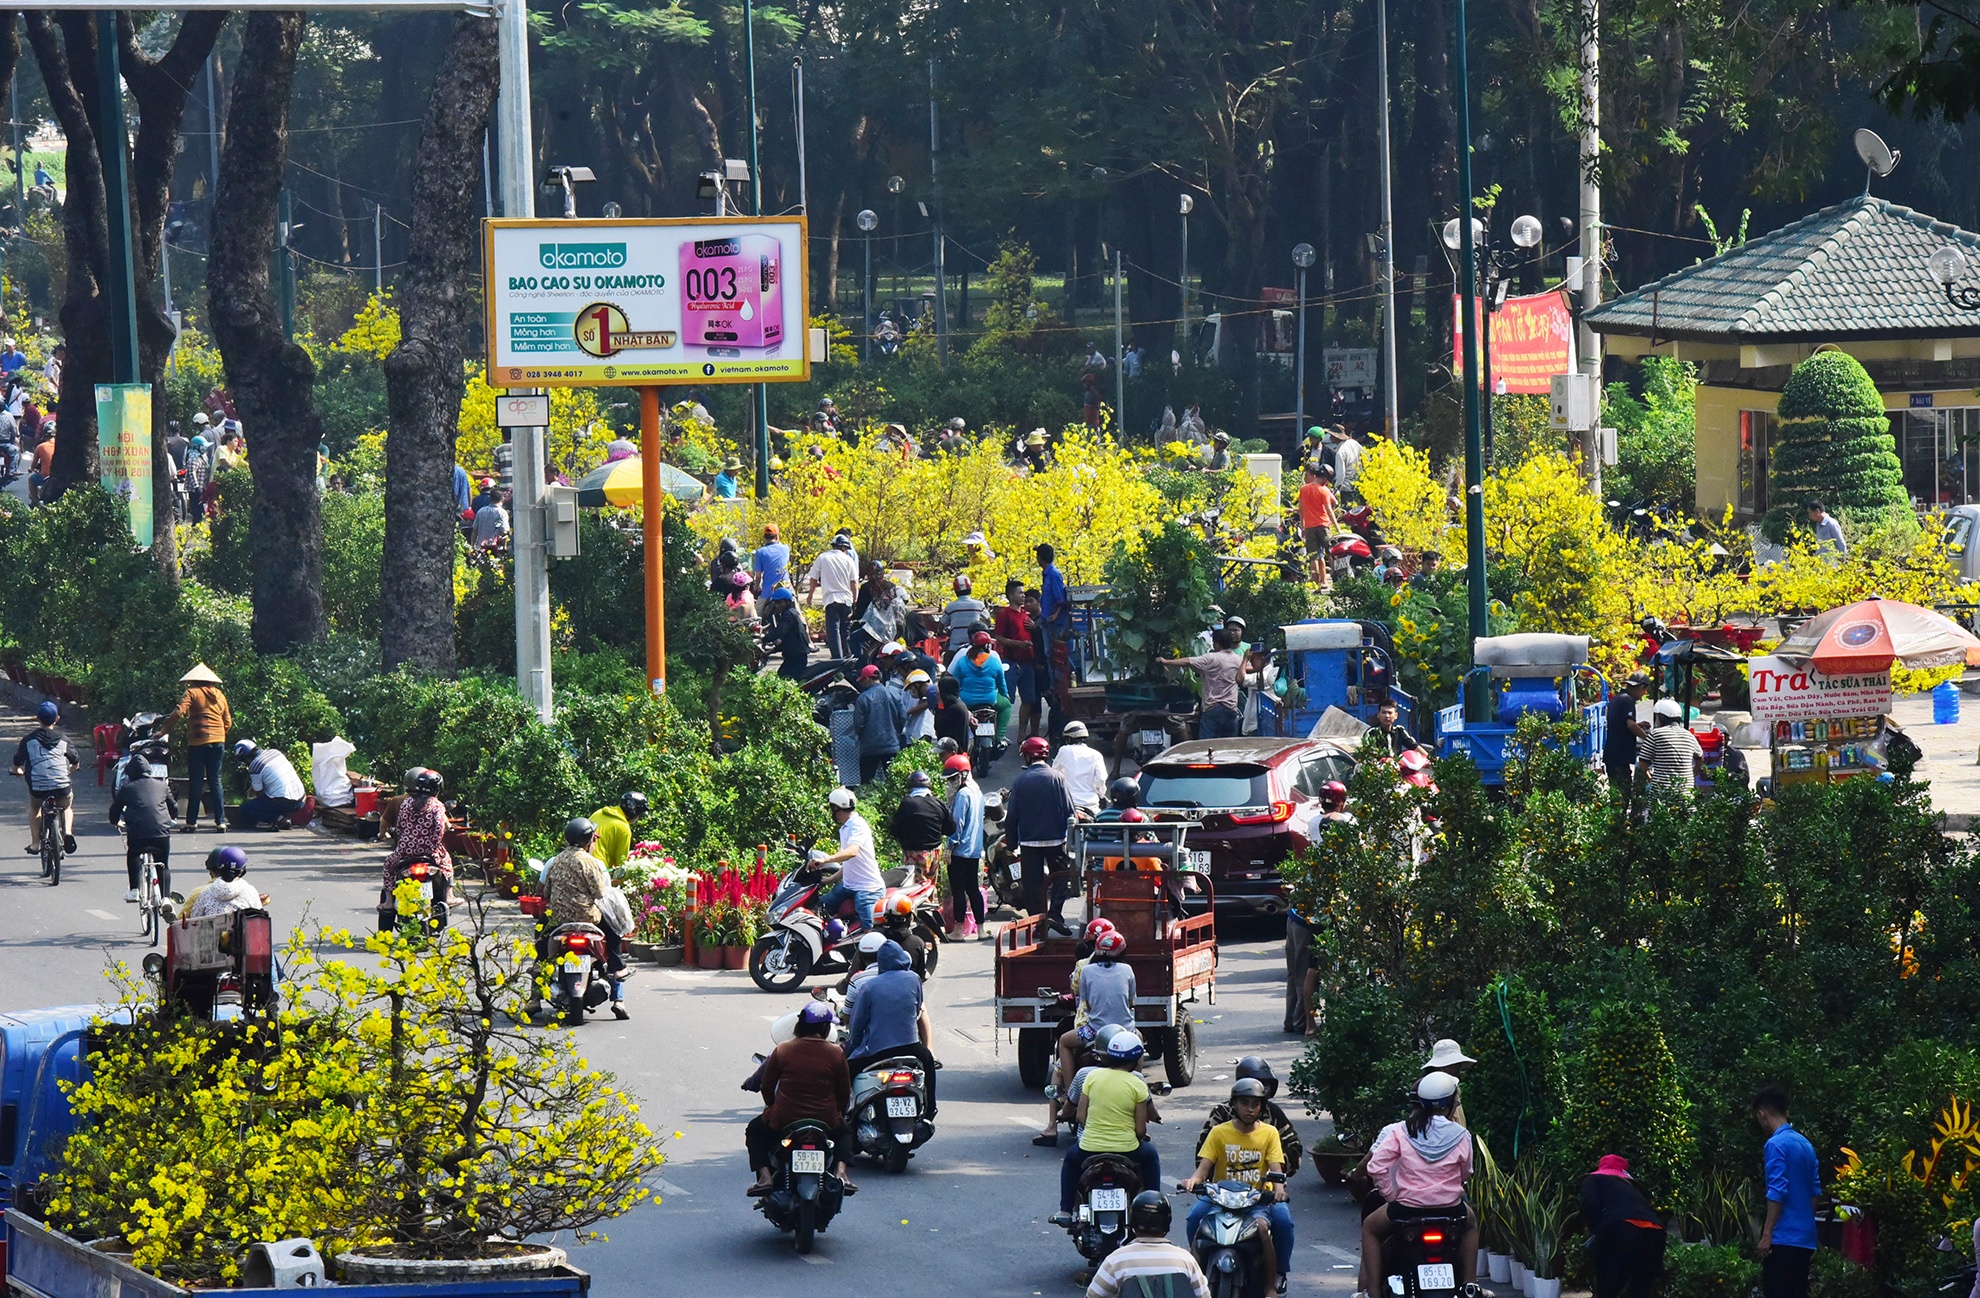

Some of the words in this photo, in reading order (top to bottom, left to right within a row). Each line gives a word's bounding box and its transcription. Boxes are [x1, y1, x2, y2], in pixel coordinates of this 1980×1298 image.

[695, 242, 740, 257] okamoto
[541, 246, 625, 267] okamoto
[508, 276, 538, 290] BAO
[540, 276, 570, 290] CAO
[573, 275, 591, 289] SU
[594, 274, 665, 289] OKAMOTO
[527, 314, 547, 322] toàn
[540, 328, 556, 336] hơn
[592, 307, 610, 354] 1
[614, 335, 644, 348] NHẬT
[621, 368, 688, 376] www.okamoto.vn
[720, 364, 790, 374] vietnam.okamoto
[130, 468, 150, 477] 2019
[890, 1098, 912, 1107] 59-V2
[890, 1107, 915, 1116] 924.58
[797, 1151, 819, 1162] 59-G1
[1225, 1150, 1237, 1163] TO
[1238, 1150, 1262, 1164] SEND
[794, 1162, 823, 1171] 517.62
[1096, 1190, 1120, 1200] 54-R4
[1097, 1200, 1121, 1209] 4535
[1423, 1266, 1448, 1276] 85-E1
[1422, 1276, 1453, 1288] 169.20
